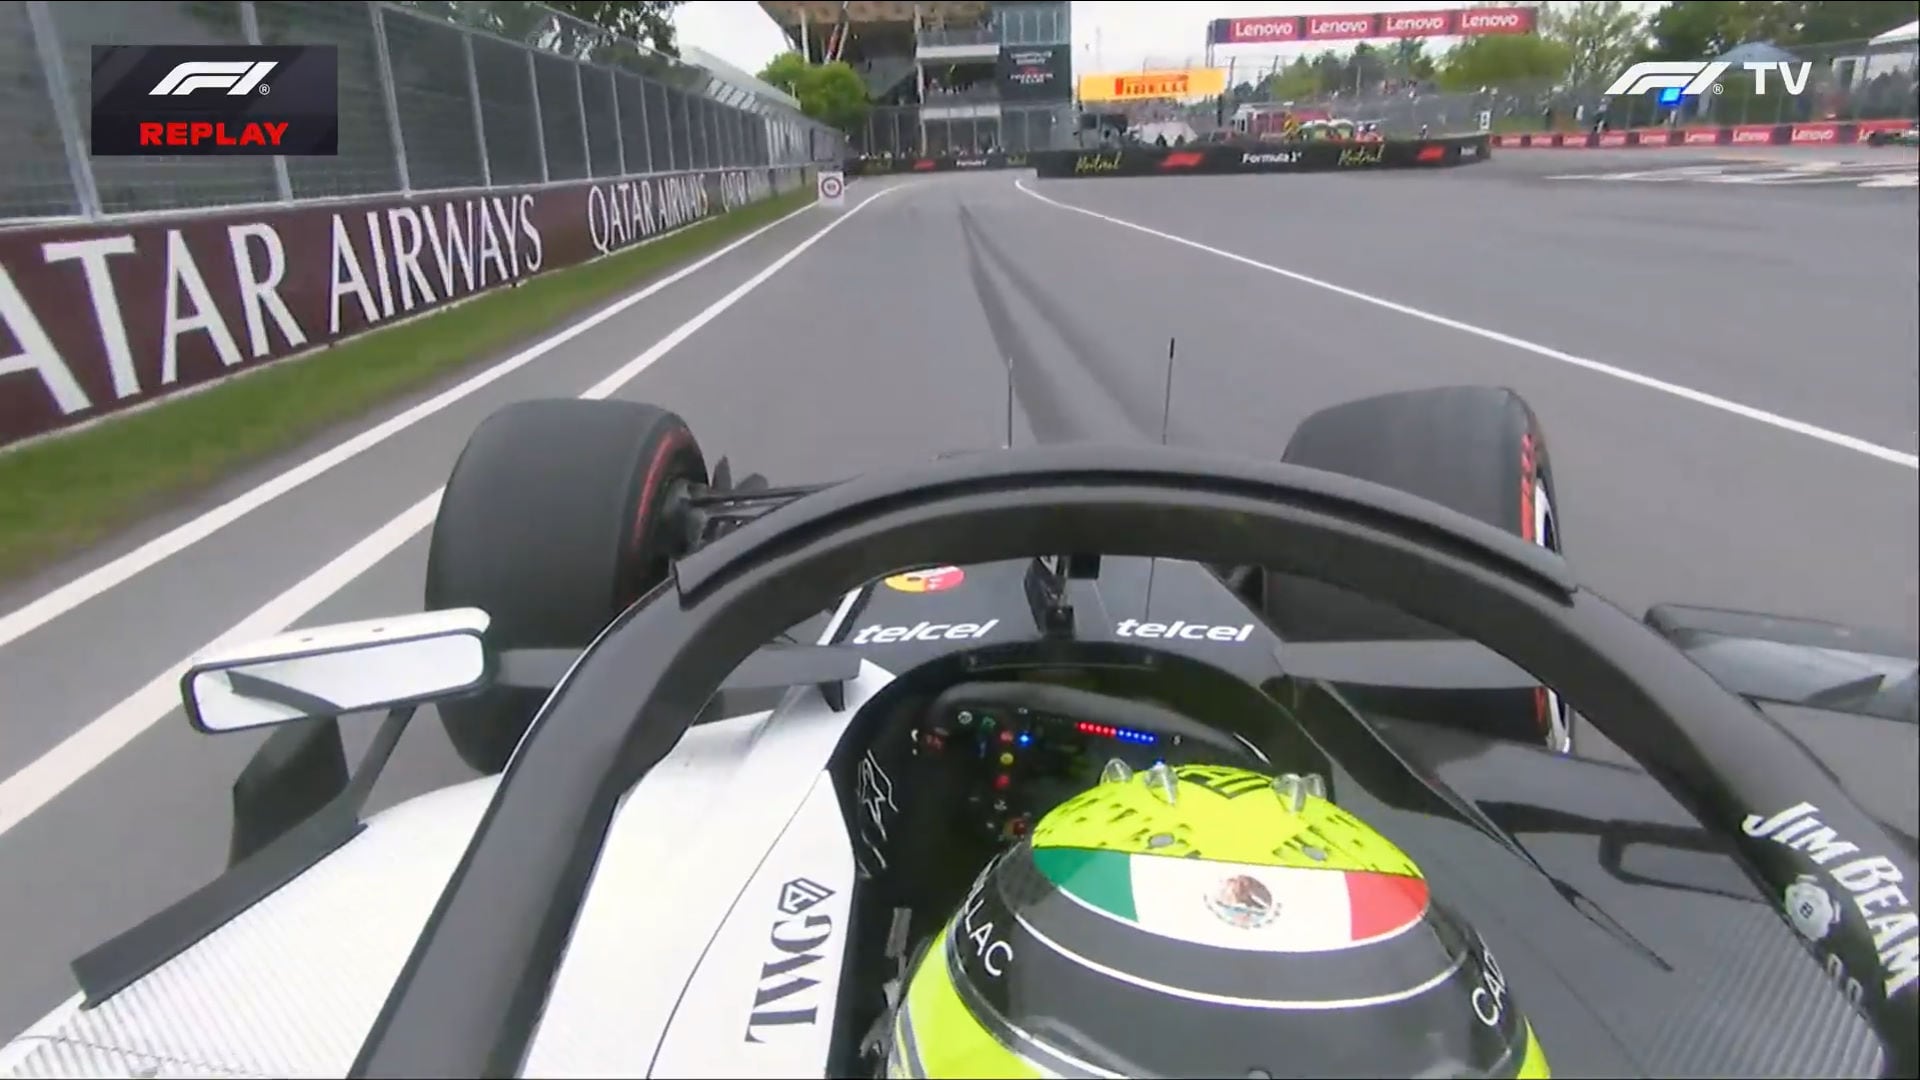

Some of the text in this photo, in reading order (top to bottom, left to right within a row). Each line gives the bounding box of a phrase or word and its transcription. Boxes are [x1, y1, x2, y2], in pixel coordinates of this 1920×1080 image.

[1235, 21, 1293, 37] Lenovo
[1311, 18, 1368, 35] Lenovo
[1387, 16, 1444, 31] Lenovo
[1462, 13, 1519, 29] Lenovo
[1791, 125, 1834, 142] Lenovo
[1242, 152, 1290, 164] Formula
[588, 180, 656, 255] QATAR
[658, 173, 709, 229] AIRWAYS
[328, 194, 542, 334] AIRWAYS
[852, 619, 999, 645] telcel
[1116, 618, 1255, 642] telcel
[1740, 801, 1860, 864] JIM
[745, 914, 833, 1044] TWG
